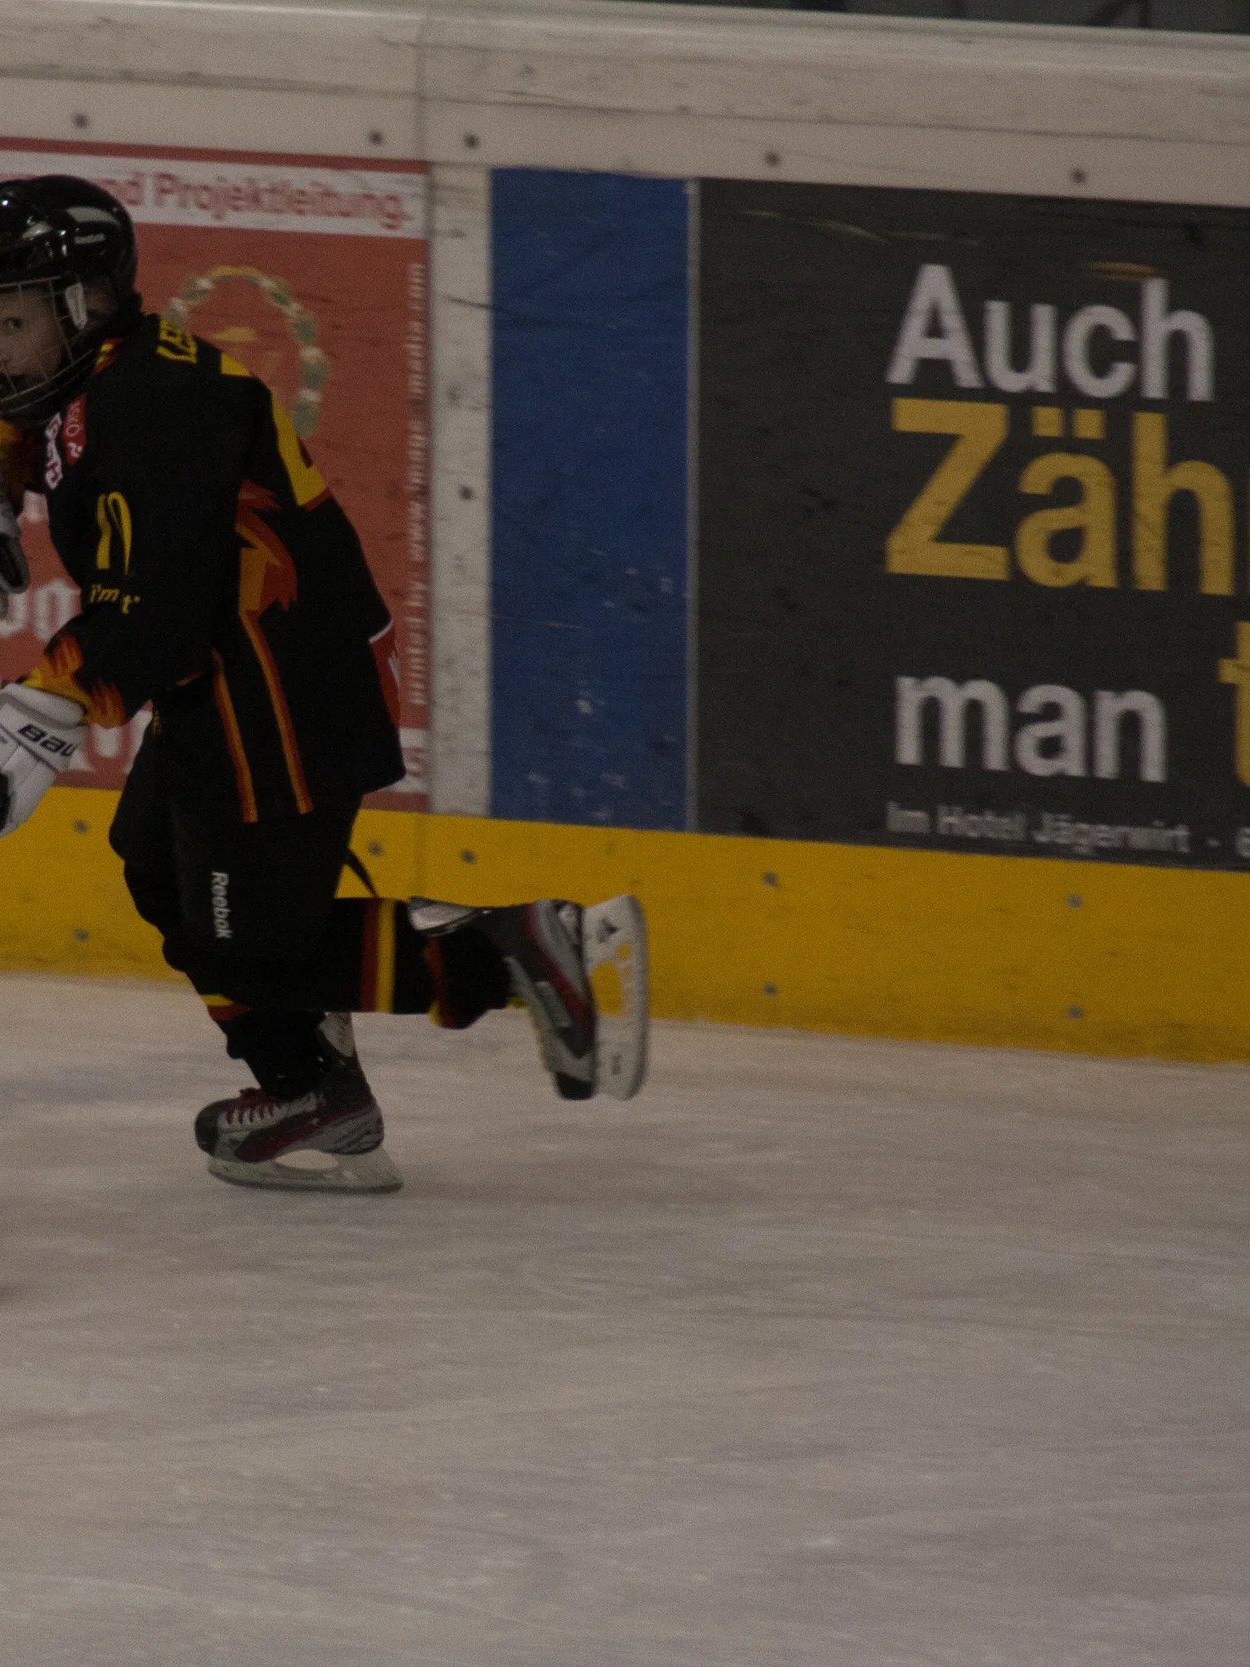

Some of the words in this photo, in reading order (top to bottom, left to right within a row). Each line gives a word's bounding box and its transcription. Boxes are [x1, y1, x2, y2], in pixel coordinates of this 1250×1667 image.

[885, 262, 1216, 403] Auch
[883, 396, 1250, 597] Zäh
[893, 674, 1167, 784] man
[937, 803, 1029, 842] Hotel
[209, 870, 234, 940] Reebok
